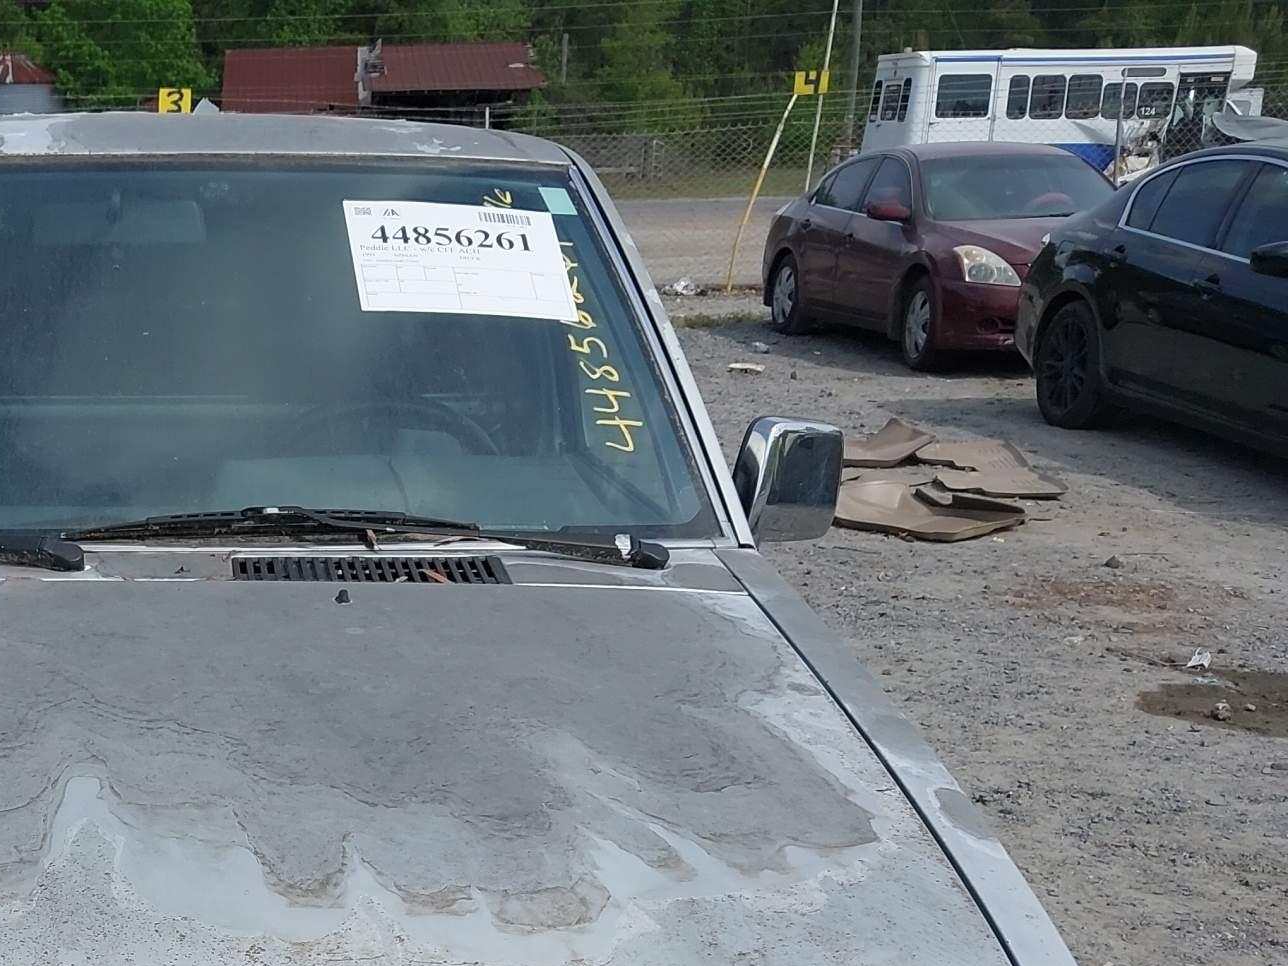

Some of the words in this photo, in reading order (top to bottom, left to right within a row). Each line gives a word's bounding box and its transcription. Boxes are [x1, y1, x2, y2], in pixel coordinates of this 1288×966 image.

[167, 90, 184, 112] 3
[1139, 106, 1157, 116] 124
[371, 224, 532, 251] 44856261
